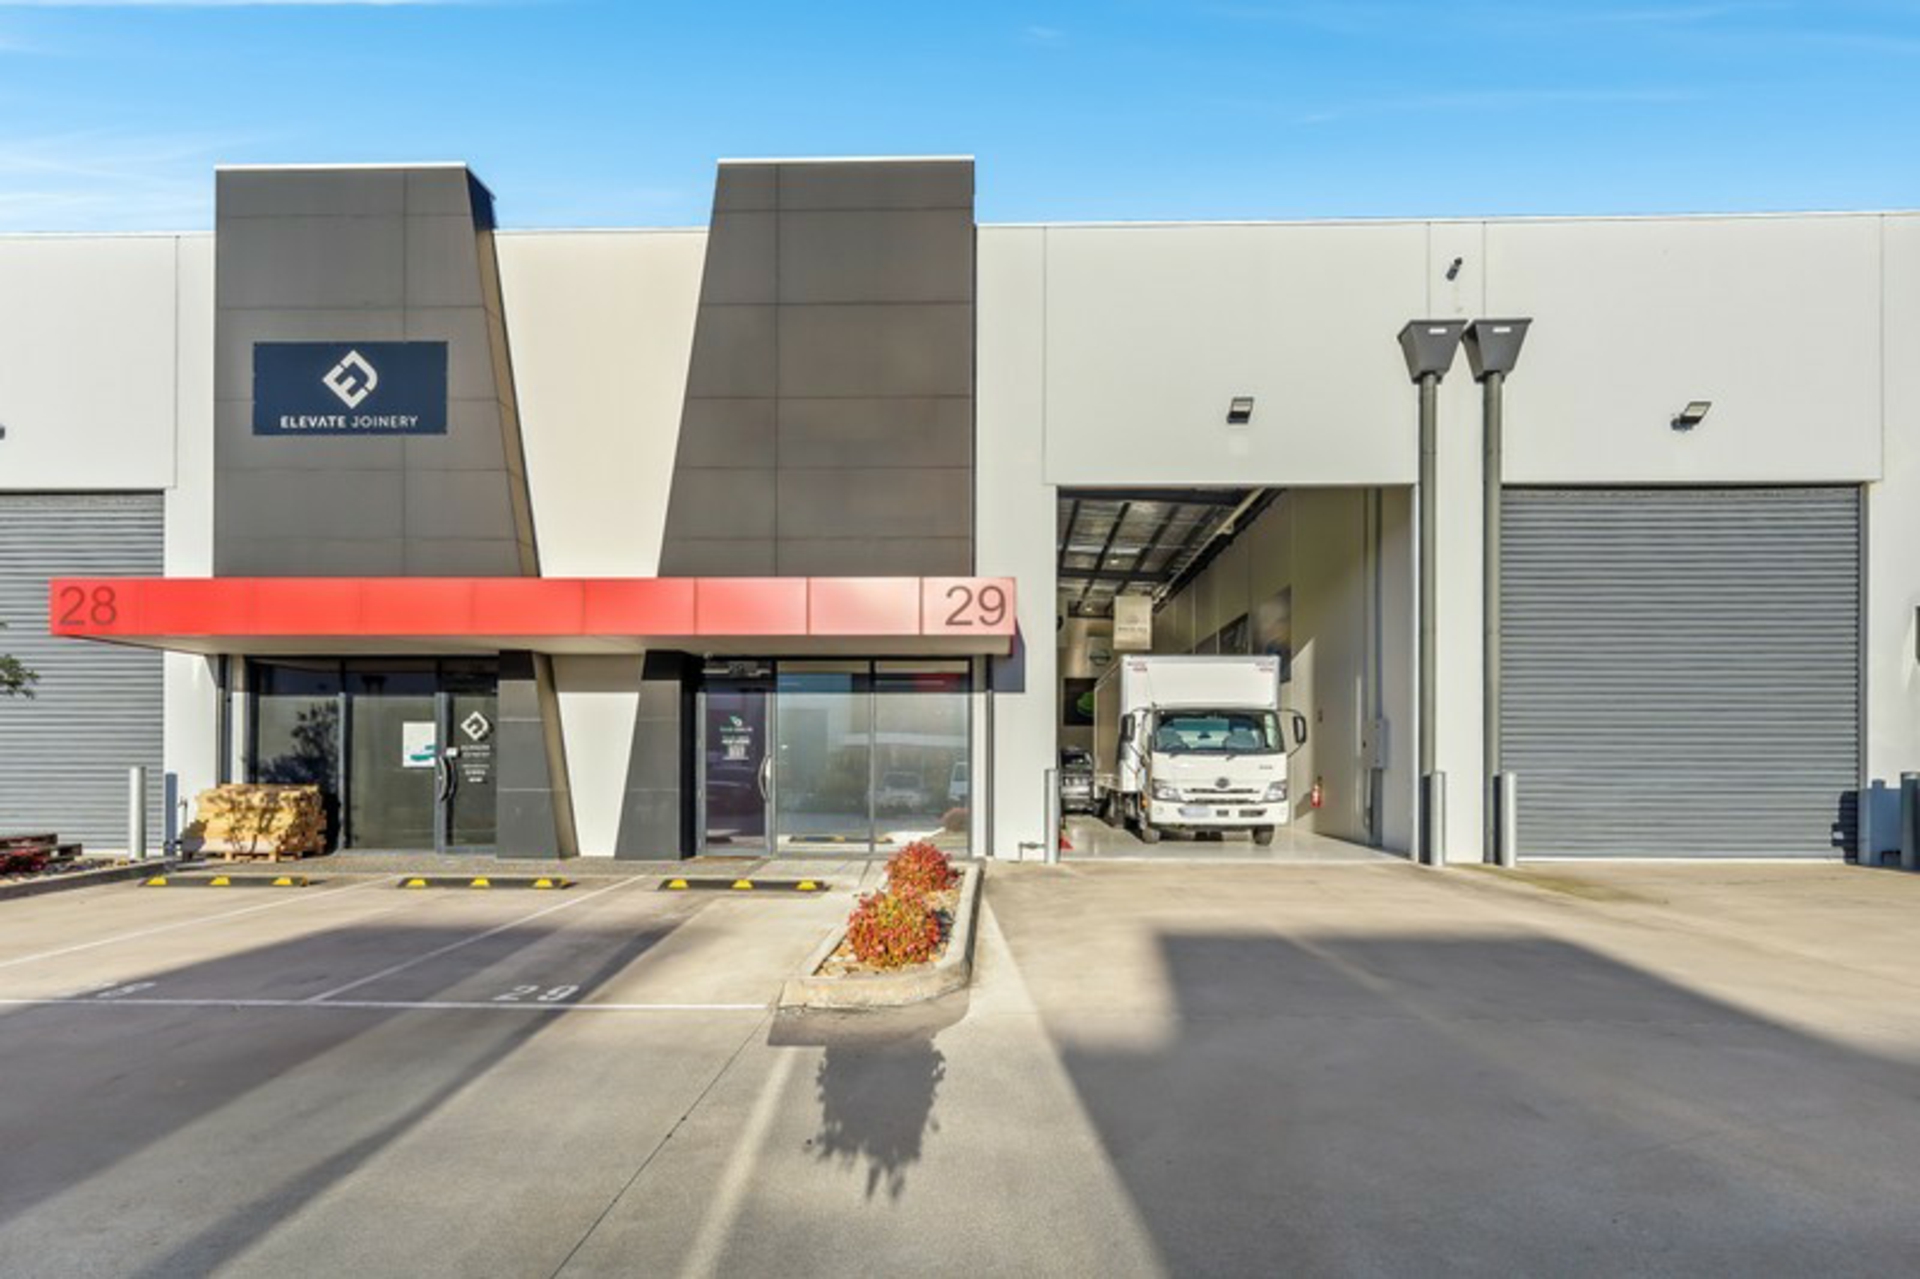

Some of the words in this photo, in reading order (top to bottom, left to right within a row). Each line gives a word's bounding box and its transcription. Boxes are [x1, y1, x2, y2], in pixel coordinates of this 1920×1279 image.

[280, 415, 346, 429] ELEVATE
[351, 415, 418, 428] JOINERY
[59, 585, 117, 626] 28
[945, 585, 1006, 626] 29
